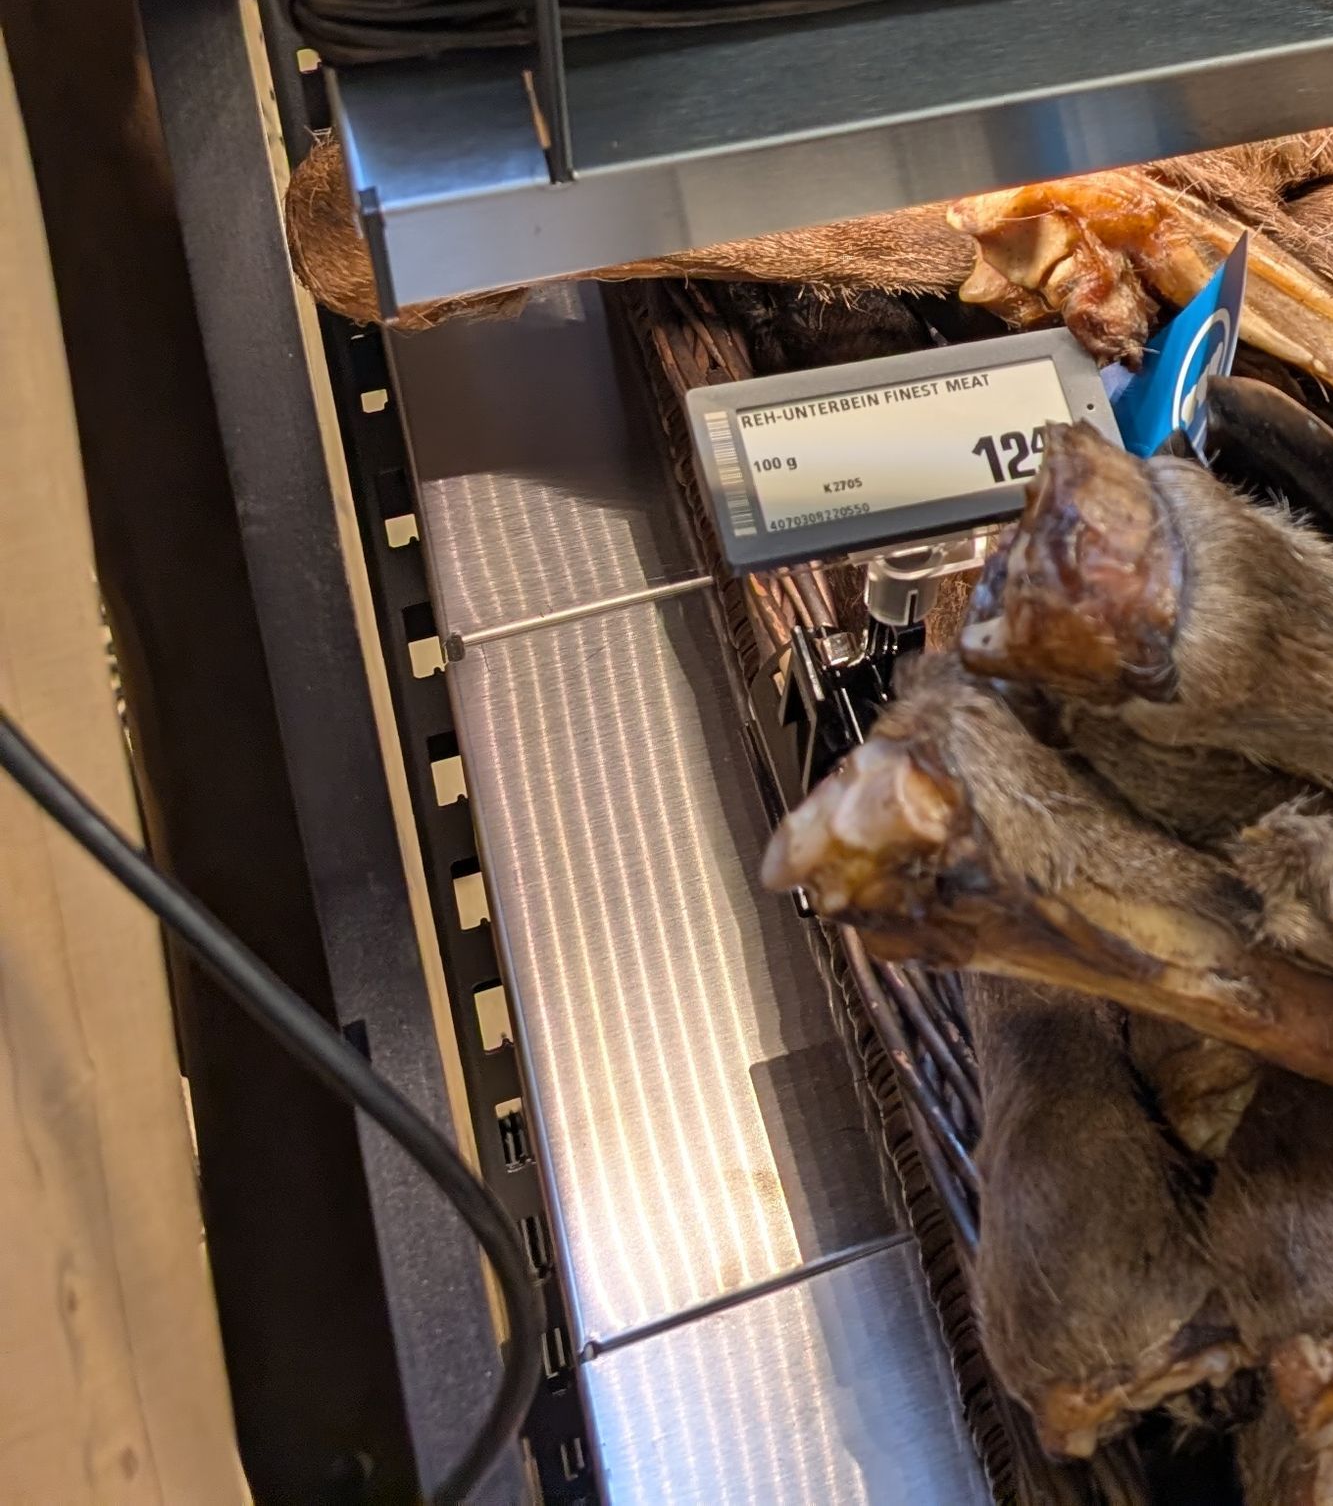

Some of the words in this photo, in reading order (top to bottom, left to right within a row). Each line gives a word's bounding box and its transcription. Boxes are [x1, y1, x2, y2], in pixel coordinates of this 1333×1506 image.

[741, 393, 880, 429] REH-UNTERBEIN
[884, 382, 940, 405] FINEST
[945, 373, 990, 393] MEAT
[753, 457, 782, 473] 100
[786, 457, 798, 471] g
